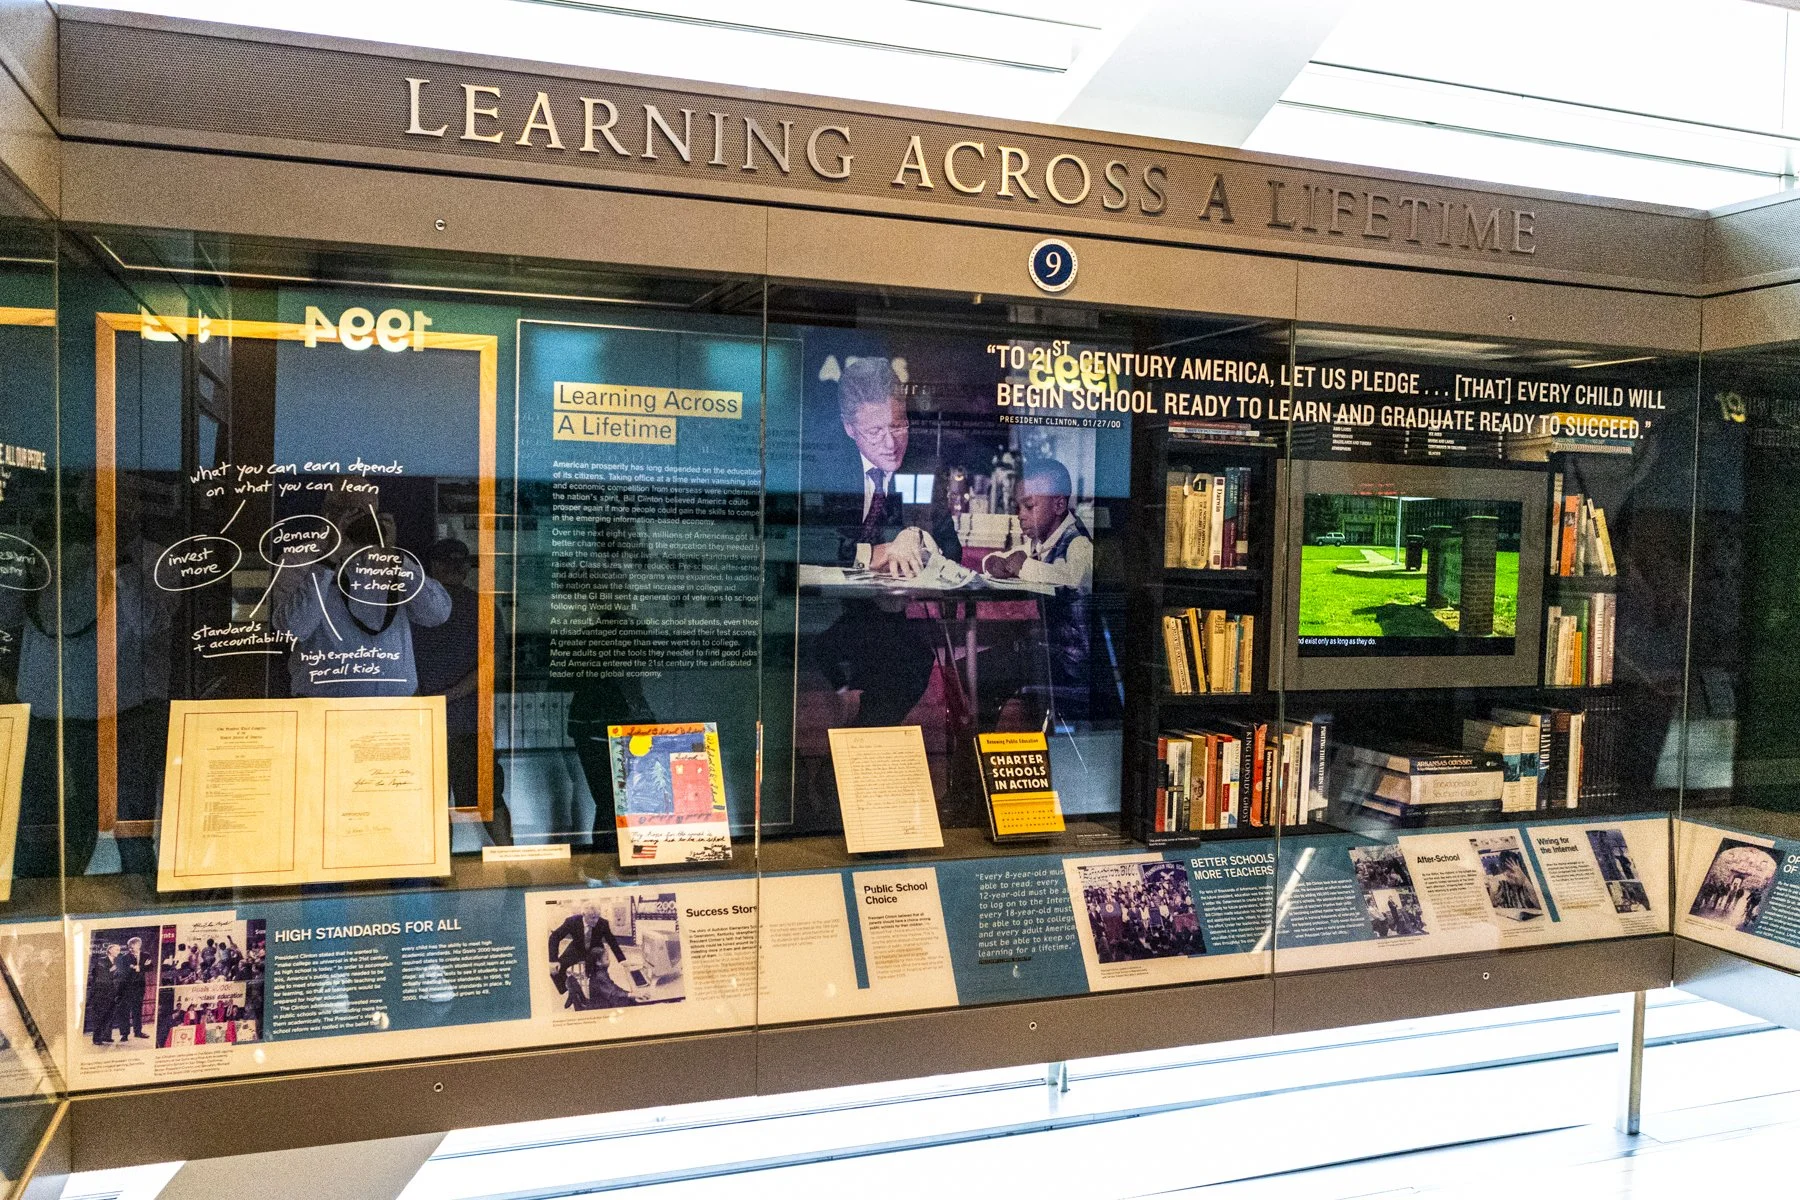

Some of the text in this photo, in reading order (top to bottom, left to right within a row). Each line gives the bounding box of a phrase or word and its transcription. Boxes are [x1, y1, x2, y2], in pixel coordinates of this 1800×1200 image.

[405, 77, 1537, 254] LEARNING ACROSS A LIFETIME
[1045, 252, 1062, 279] 9
[1079, 351, 1177, 379] CENTURY
[1180, 357, 1274, 388] AMERICA,
[1281, 365, 1316, 388] LET
[1321, 367, 1346, 389] US
[1352, 369, 1419, 394] PLEDGE
[1456, 374, 1511, 403] [THAT]
[1517, 381, 1571, 404] EVERY
[1575, 384, 1625, 407] CHILD
[1628, 388, 1666, 410] WILL
[560, 384, 738, 413] Learning Across
[997, 383, 1064, 408] BEGIN
[1072, 388, 1158, 414] SCHOOL
[1164, 393, 1231, 417] READY
[1236, 397, 1261, 419] TO
[1268, 399, 1332, 423] LEARN
[1337, 403, 1375, 427] AND
[1381, 406, 1474, 432] GRADUATE
[1480, 410, 1535, 434] READY
[1540, 413, 1560, 435] TO
[557, 414, 671, 439] A Lifetime
[999, 414, 1121, 429] PRESIDENT CLINTON, 01/27/00
[190, 457, 404, 484] what you can earn depends
[553, 460, 589, 469] American
[591, 462, 628, 472] prosperity
[631, 464, 644, 472] has
[647, 464, 662, 474] long
[664, 466, 700, 475] depended
[713, 467, 725, 475] the
[206, 479, 379, 498] on what you can learn
[273, 525, 330, 544] demand
[283, 542, 320, 553] more
[168, 549, 213, 566] invest
[368, 552, 402, 564] more
[181, 563, 221, 577] more
[355, 564, 414, 580] innovation
[364, 580, 407, 592] choice
[191, 621, 262, 641] standards
[209, 632, 298, 652] accountability
[1318, 638, 1329, 646] only
[1337, 638, 1348, 646] long
[1356, 638, 1367, 646] they
[301, 646, 400, 666] high expectations
[332, 664, 350, 676] all
[551, 670, 574, 678] leader
[600, 670, 624, 679] global
[1245, 731, 1253, 753] KING
[990, 754, 1044, 765] CHARTER
[992, 766, 1046, 778] SCHOOLS
[995, 778, 1049, 790] IN ACTION
[1536, 836, 1570, 847] Wiring for
[1540, 844, 1578, 854] the Internet
[1191, 853, 1275, 868] BETTER SCHOOLS
[1416, 854, 1460, 864] After-School
[1004, 869, 1047, 880] 8-year-old
[1193, 869, 1223, 881] MORE
[1223, 866, 1275, 878] TEACHERS
[1783, 864, 1798, 873] OF
[863, 881, 928, 894] Public School
[979, 882, 997, 890] able
[1036, 879, 1059, 887] every
[865, 894, 897, 905] Choice
[979, 889, 1026, 900] 12-year-old
[686, 905, 758, 918] Success Stor
[979, 905, 1072, 919] every 18-year-old must
[990, 901, 1003, 910] log
[274, 929, 312, 943] HIGH
[315, 922, 401, 940] STANDARDS
[405, 920, 434, 934] FOR
[437, 918, 462, 932] ALL
[996, 929, 1019, 937] every
[1021, 926, 1043, 935] adult
[1043, 935, 1063, 944] keep
[978, 948, 1013, 958] learning
[1016, 946, 1028, 954] for
